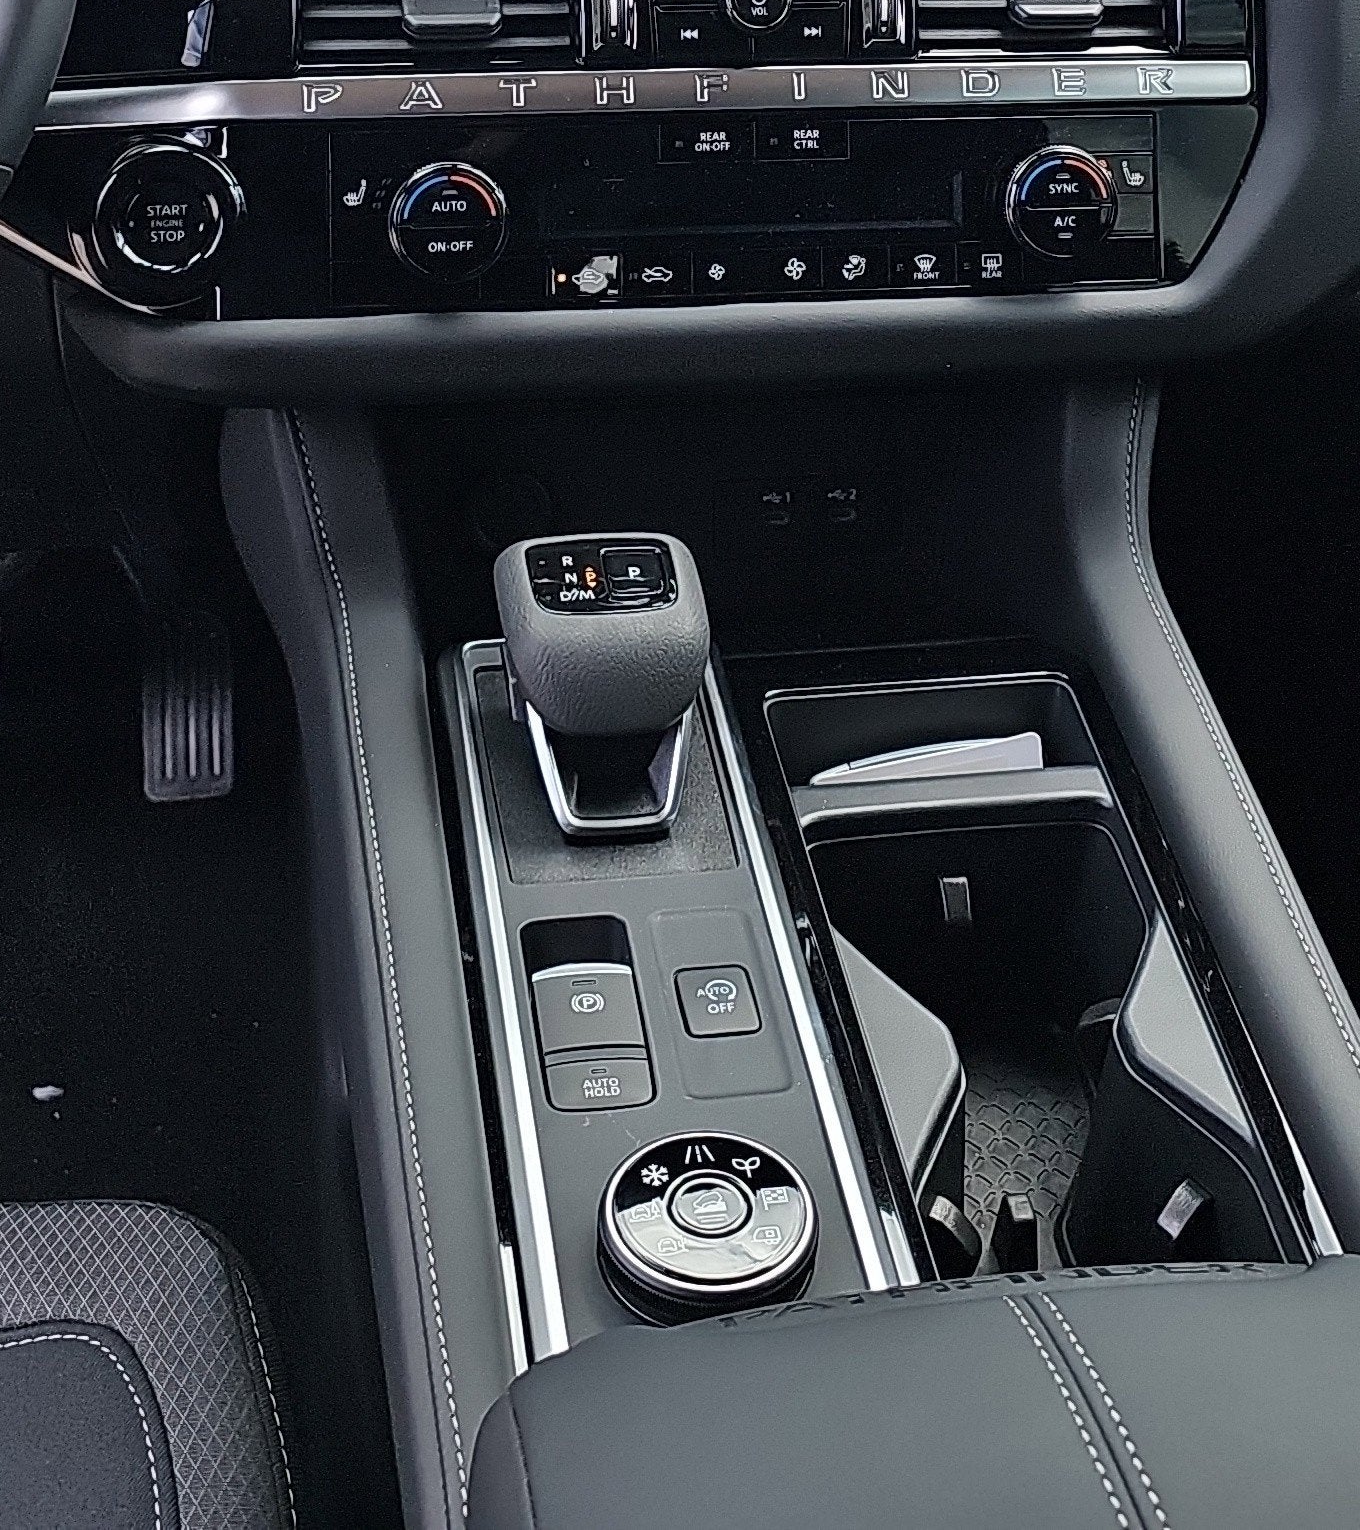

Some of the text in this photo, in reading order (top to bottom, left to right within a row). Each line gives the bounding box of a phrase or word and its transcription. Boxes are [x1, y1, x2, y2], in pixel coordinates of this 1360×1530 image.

[750, 6, 769, 16] VOL
[301, 66, 1176, 113] PATHFINDER
[700, 131, 727, 141] REAR
[793, 129, 820, 139] REAR
[793, 140, 820, 149] CTRL
[1048, 182, 1080, 195] SYNC
[146, 204, 188, 217] START
[431, 200, 467, 213] AUTO
[1053, 215, 1077, 227] A/C
[150, 230, 186, 242] STOP
[913, 271, 940, 280] FRONT
[981, 270, 1003, 278] REAR
[561, 555, 574, 566] R
[564, 572, 578, 585] N
[585, 572, 597, 582] P
[627, 566, 641, 579] P
[559, 587, 596, 602] D/M
[696, 986, 730, 998] AUTO
[706, 1002, 735, 1014] OFF
[582, 1077, 619, 1089] AUTO
[584, 1086, 621, 1098] HOLD
